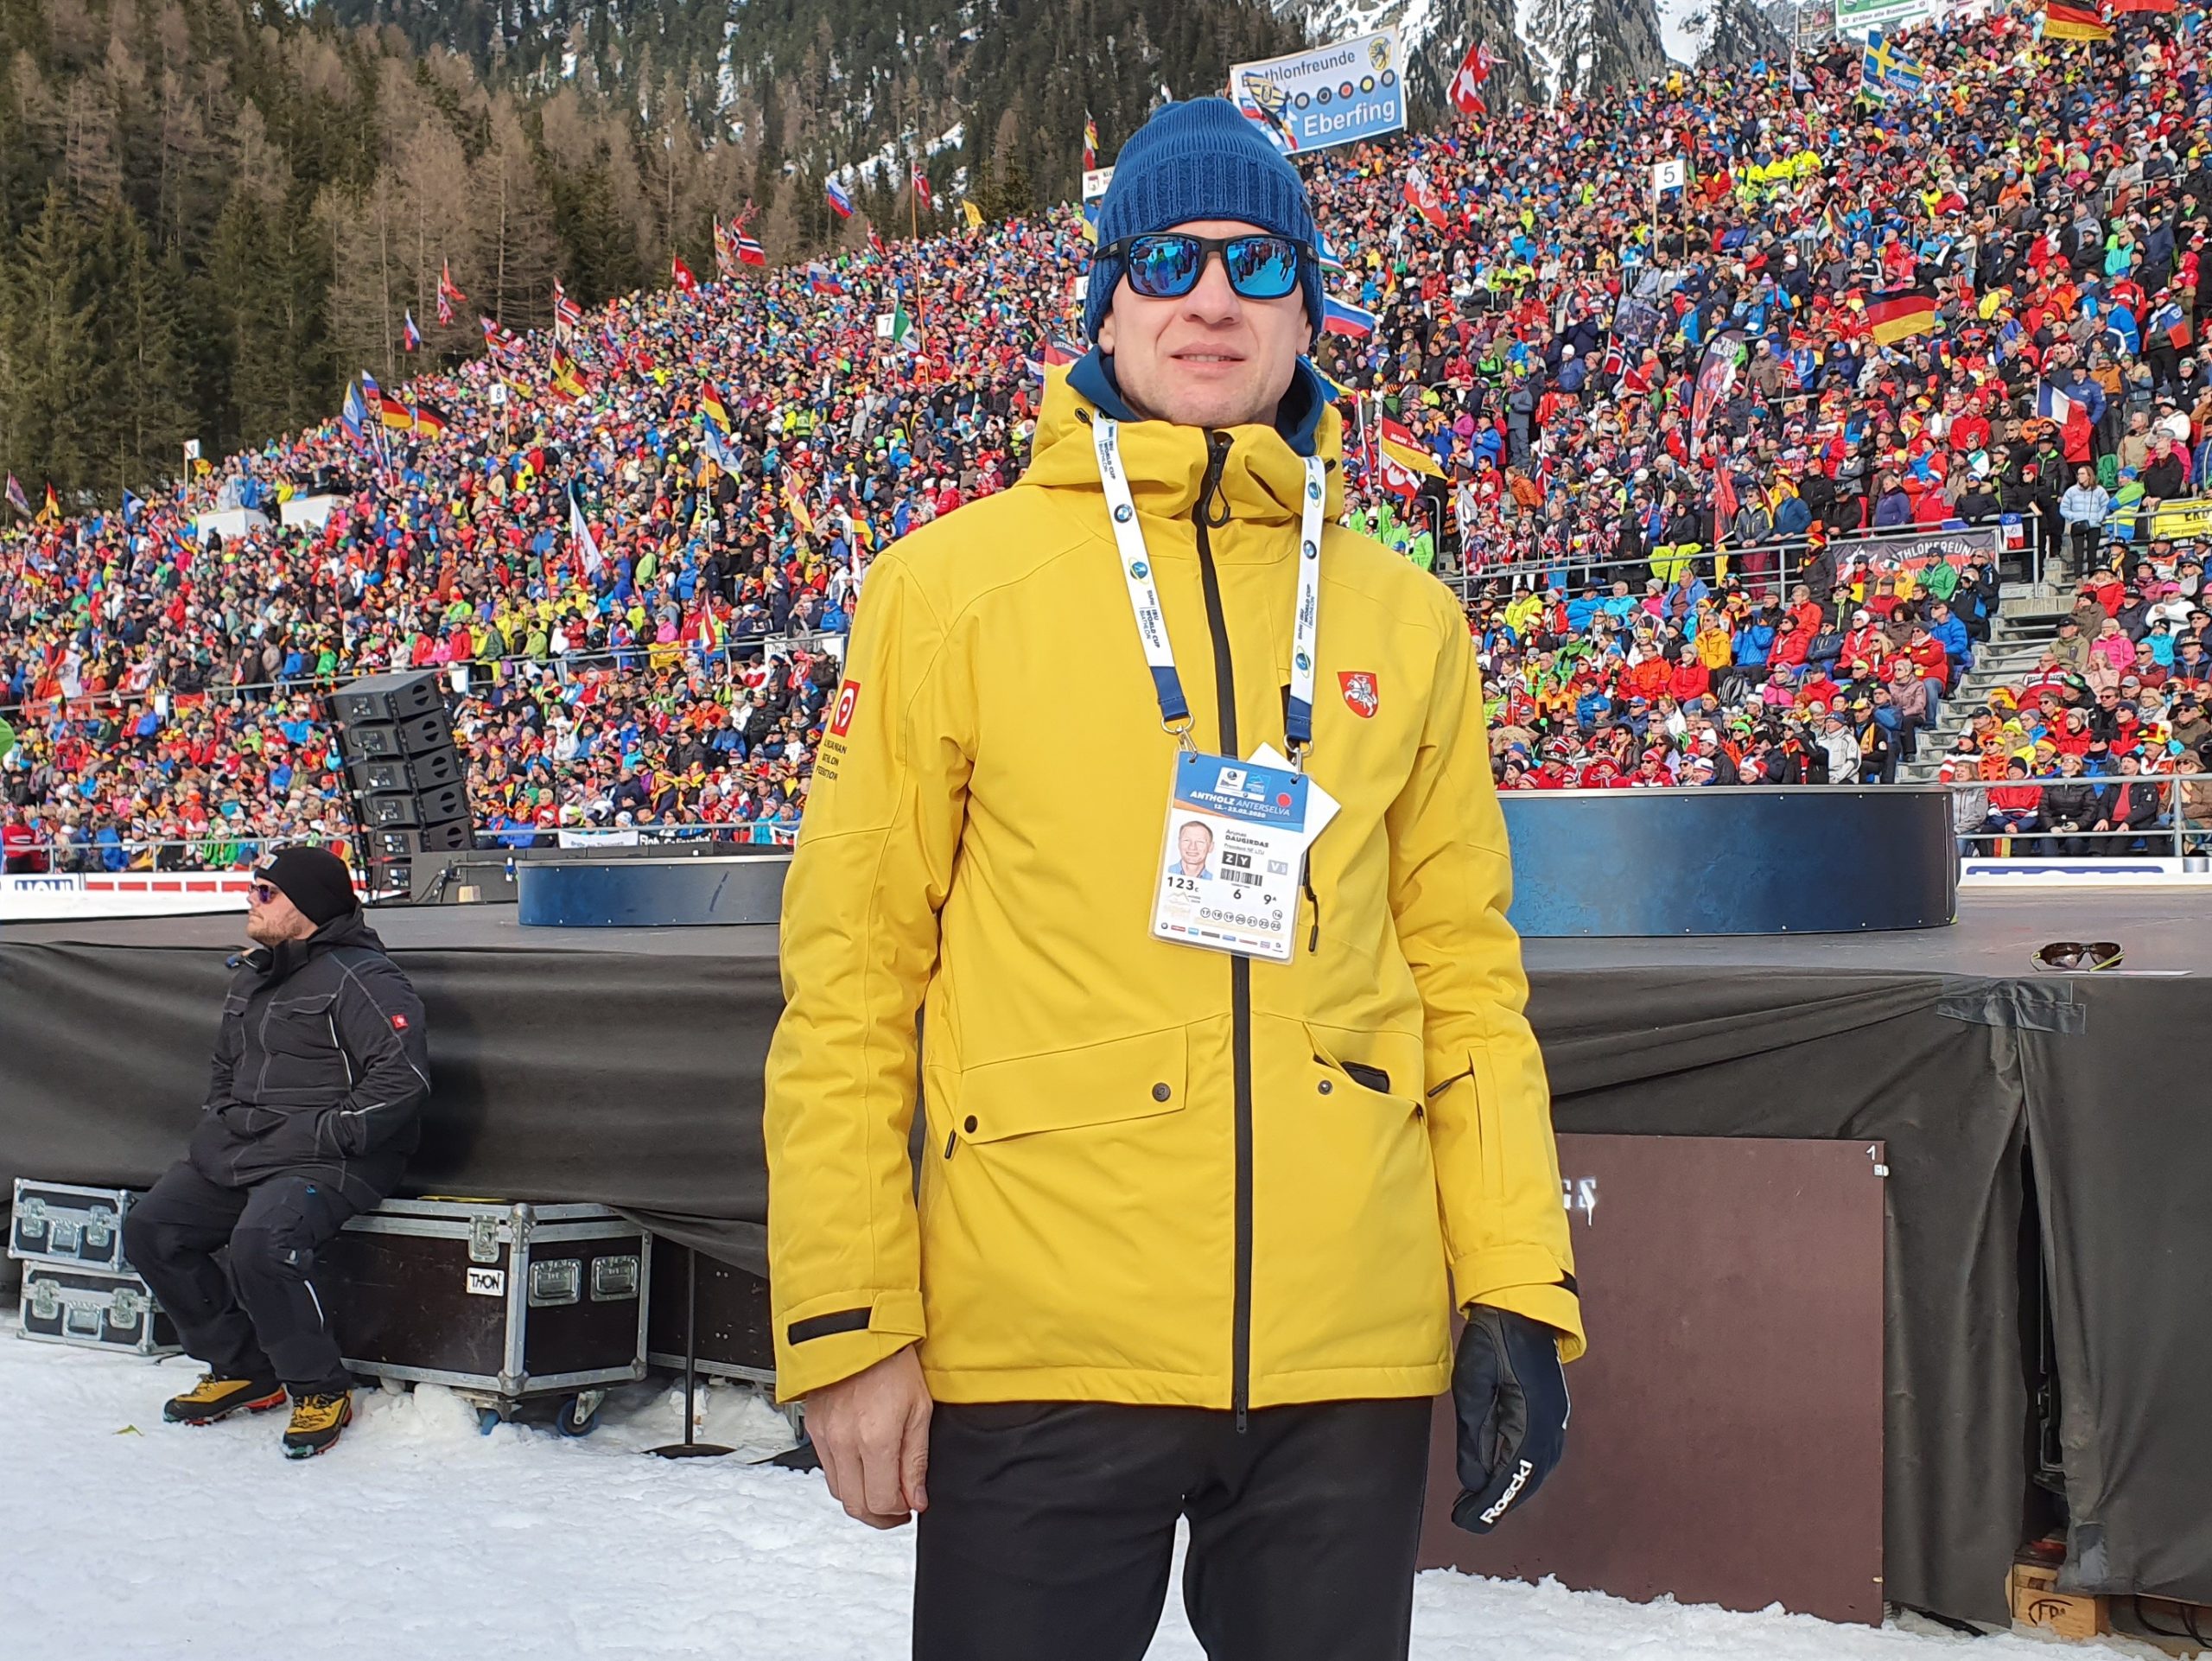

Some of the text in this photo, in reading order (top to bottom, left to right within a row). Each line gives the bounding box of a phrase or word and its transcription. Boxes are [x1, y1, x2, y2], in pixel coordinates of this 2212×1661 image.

[1304, 99, 1395, 137] Eberfing
[1663, 164, 1675, 184] 5
[884, 317, 892, 333] 7
[496, 387, 502, 399] 8
[1189, 790, 1291, 817] ANTHOLZ ANTERSELVA
[1224, 835, 1269, 849] DAUGIRDAS
[1233, 888, 1243, 900] 6
[1866, 1144, 1876, 1161] 1
[469, 1272, 502, 1290] THON
